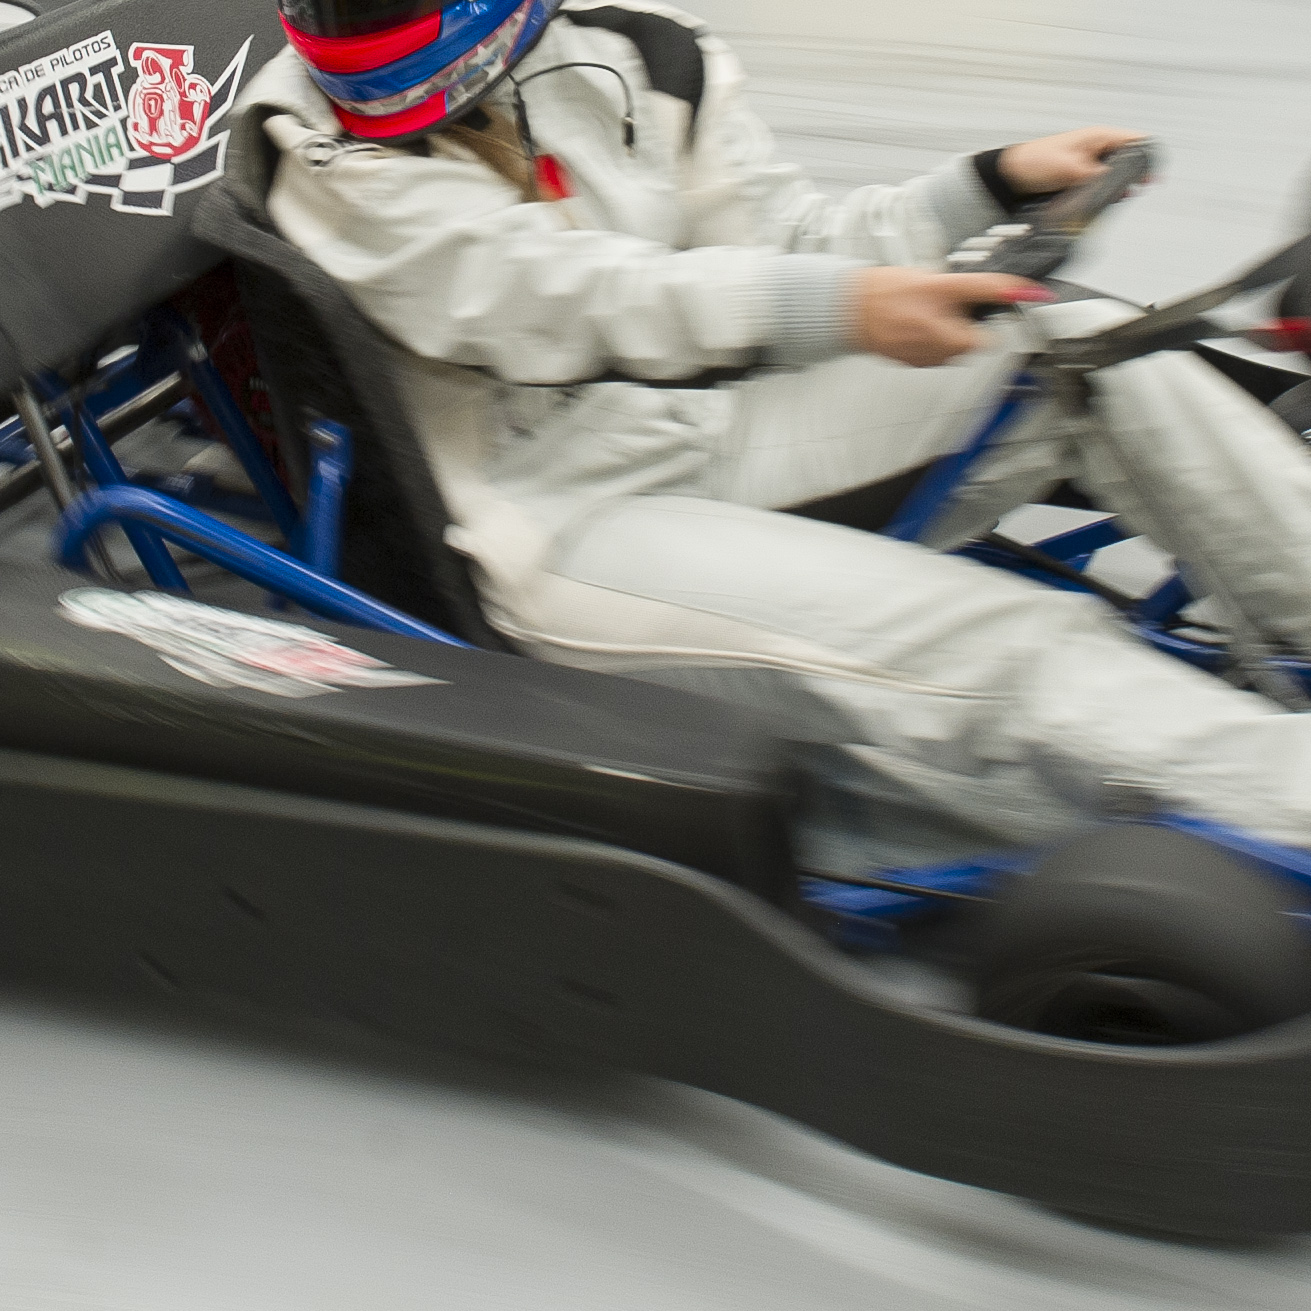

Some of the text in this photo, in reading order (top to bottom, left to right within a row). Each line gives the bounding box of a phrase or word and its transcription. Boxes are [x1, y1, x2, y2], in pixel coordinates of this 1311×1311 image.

[24, 64, 46, 82] DE
[50, 36, 112, 72] PILOTOS
[29, 125, 125, 195] MANIA
